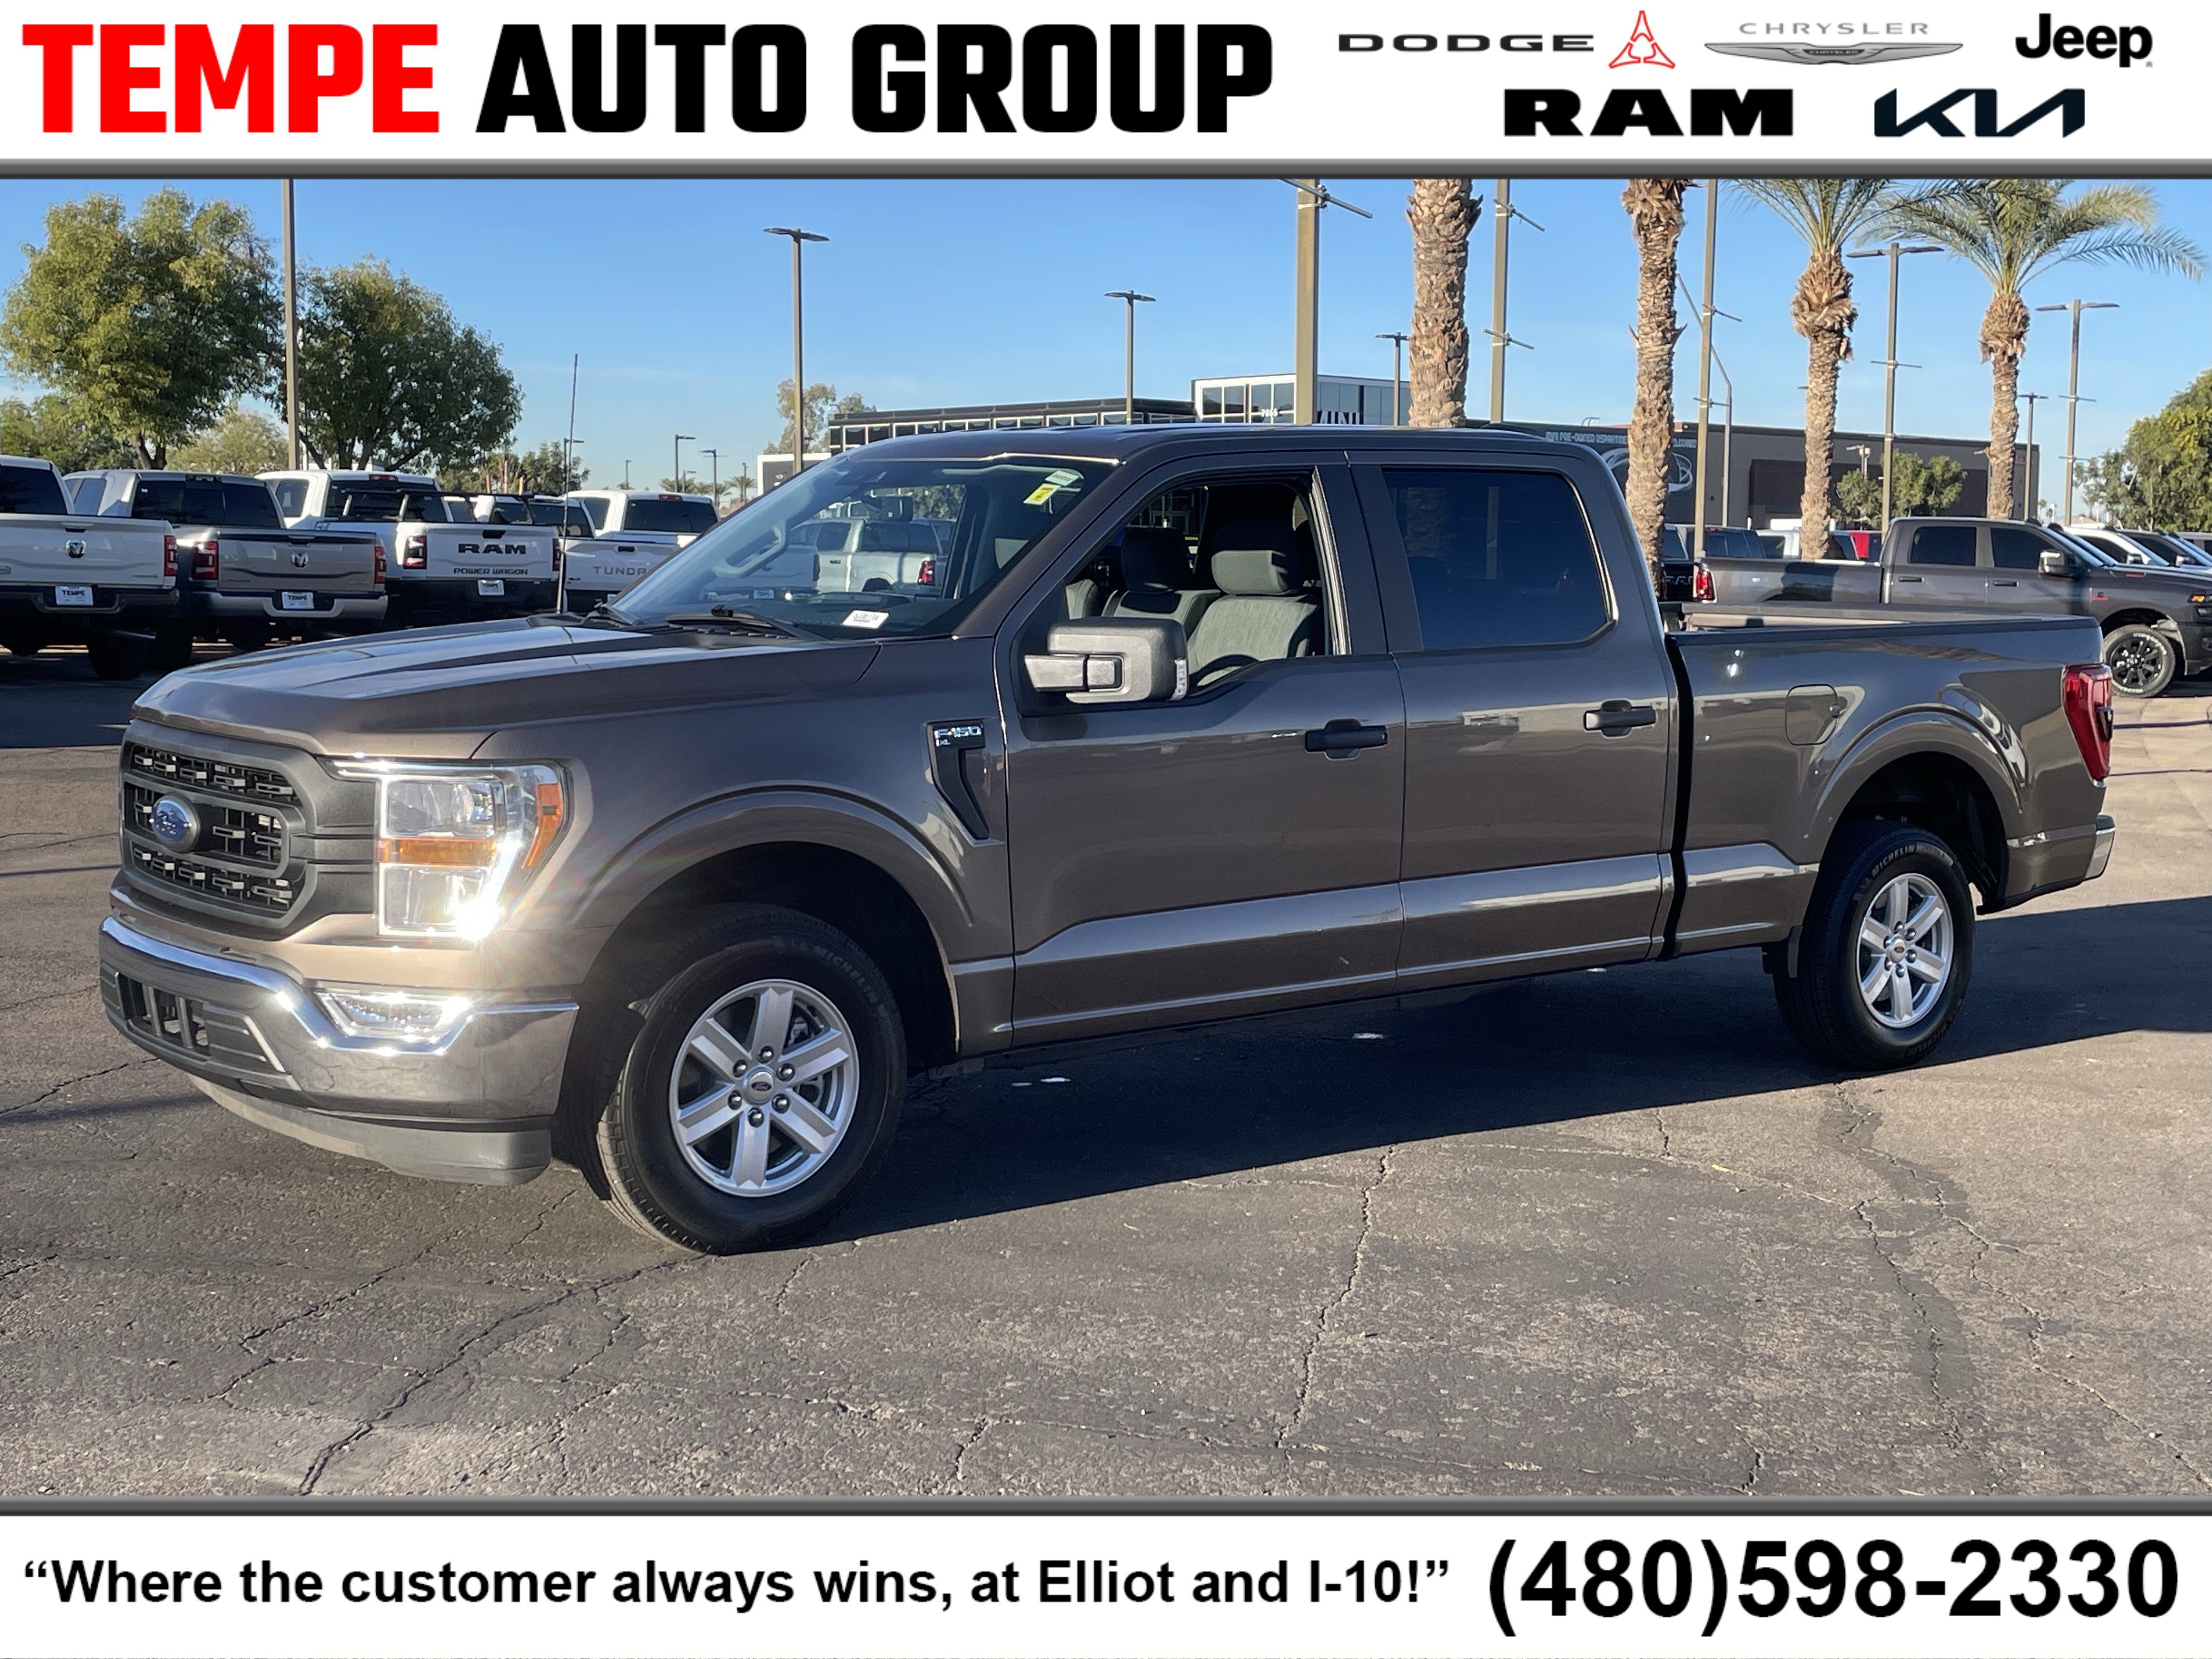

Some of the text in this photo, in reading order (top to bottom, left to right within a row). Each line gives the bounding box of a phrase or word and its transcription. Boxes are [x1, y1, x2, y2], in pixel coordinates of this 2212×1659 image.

[458, 543, 526, 554] RAM
[592, 566, 648, 576] TUNDR
[934, 726, 981, 738] F-150
[1871, 844, 1916, 878] MICHELIN
